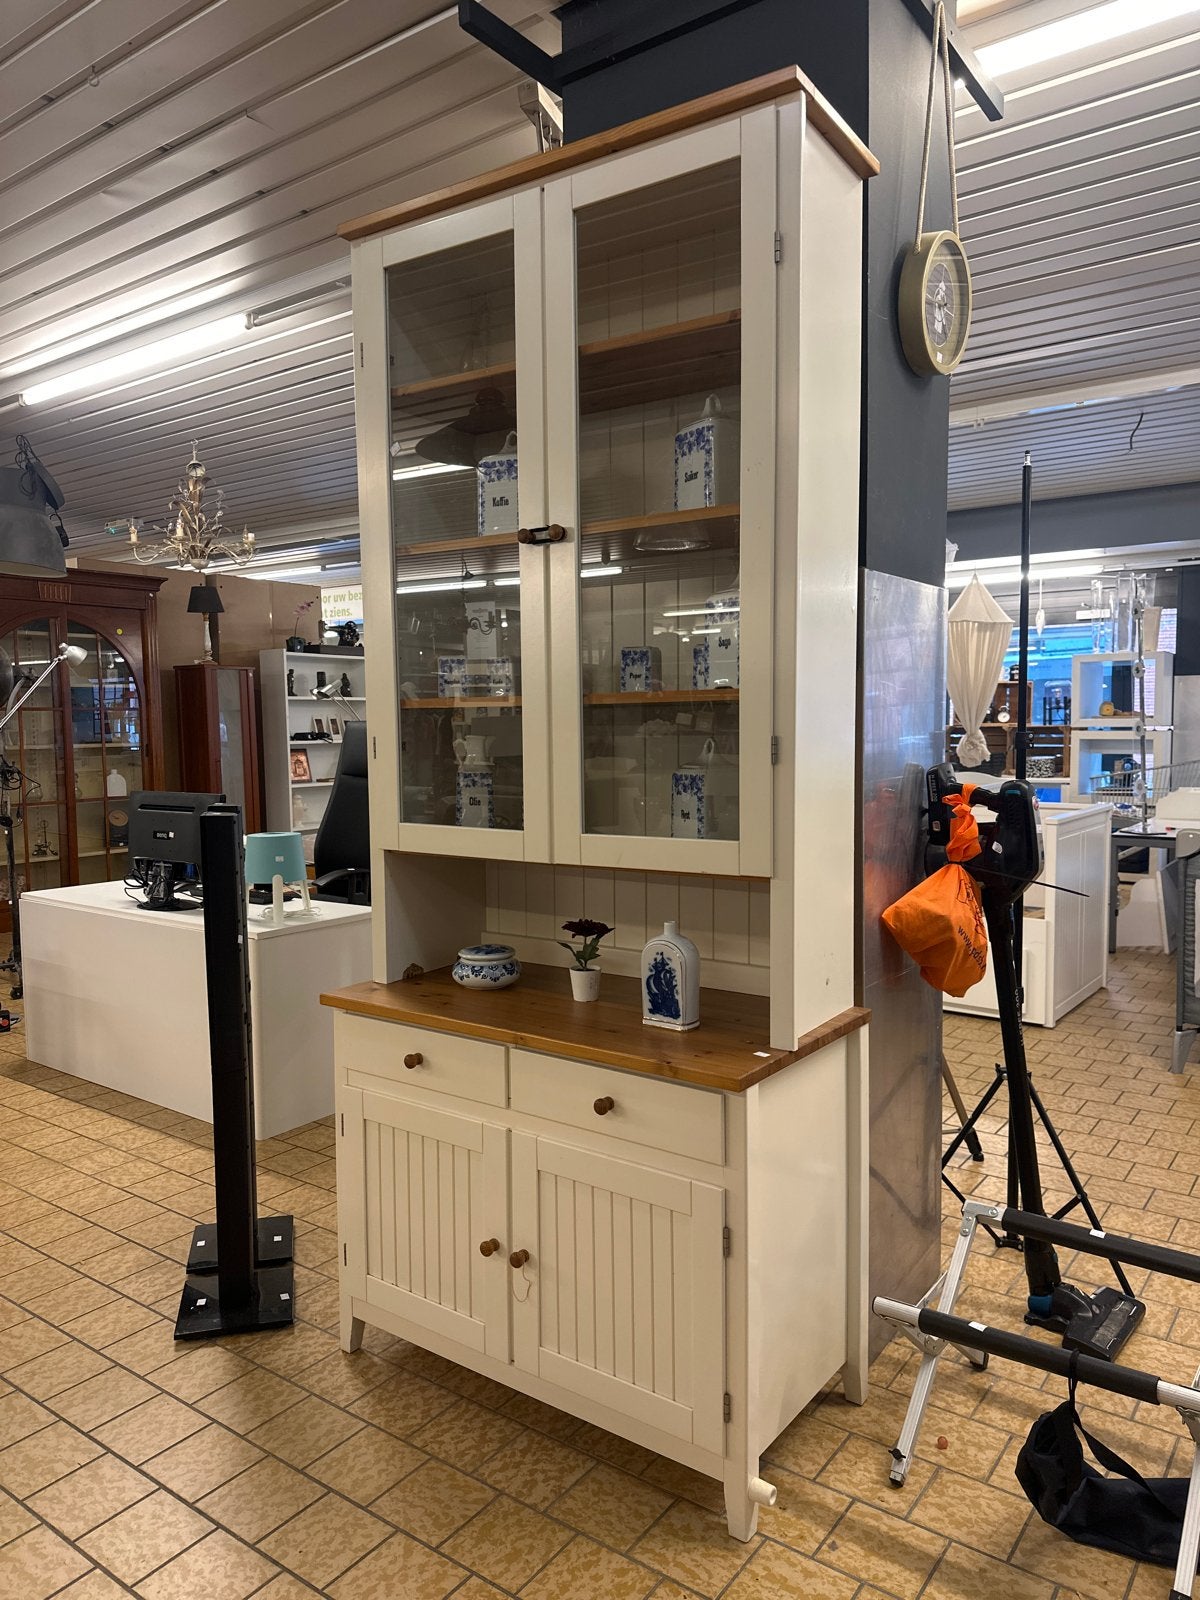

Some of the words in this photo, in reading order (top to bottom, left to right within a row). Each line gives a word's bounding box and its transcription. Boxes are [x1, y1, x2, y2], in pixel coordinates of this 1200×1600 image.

[492, 496, 510, 507] Koffie
[333, 593, 346, 603] uw
[330, 606, 352, 617] ziens.
